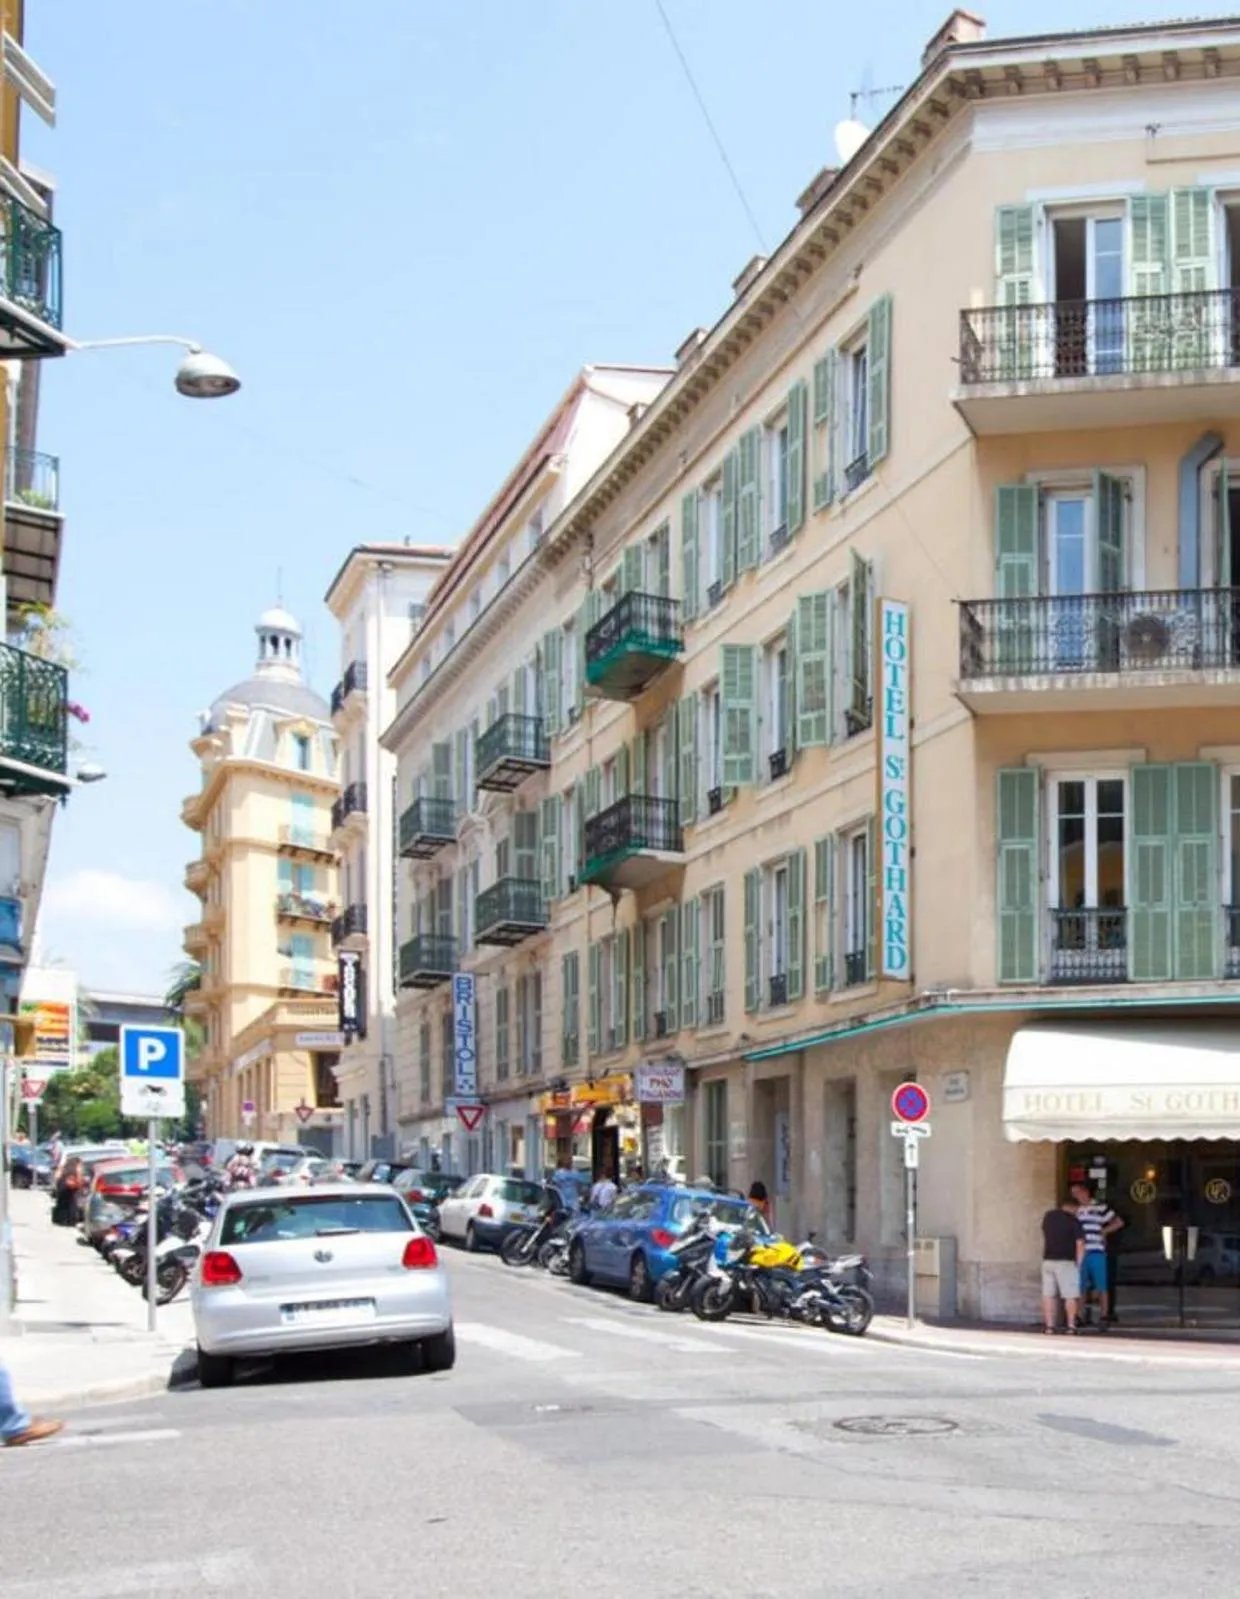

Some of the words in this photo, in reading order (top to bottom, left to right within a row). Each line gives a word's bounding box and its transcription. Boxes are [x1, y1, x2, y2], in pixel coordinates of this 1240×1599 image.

[884, 608, 907, 741] HOTEL
[883, 788, 907, 971] GOTHARD
[138, 1037, 167, 1070] P
[456, 976, 474, 1075] BRISTOL
[1023, 1092, 1106, 1113] HOTEL
